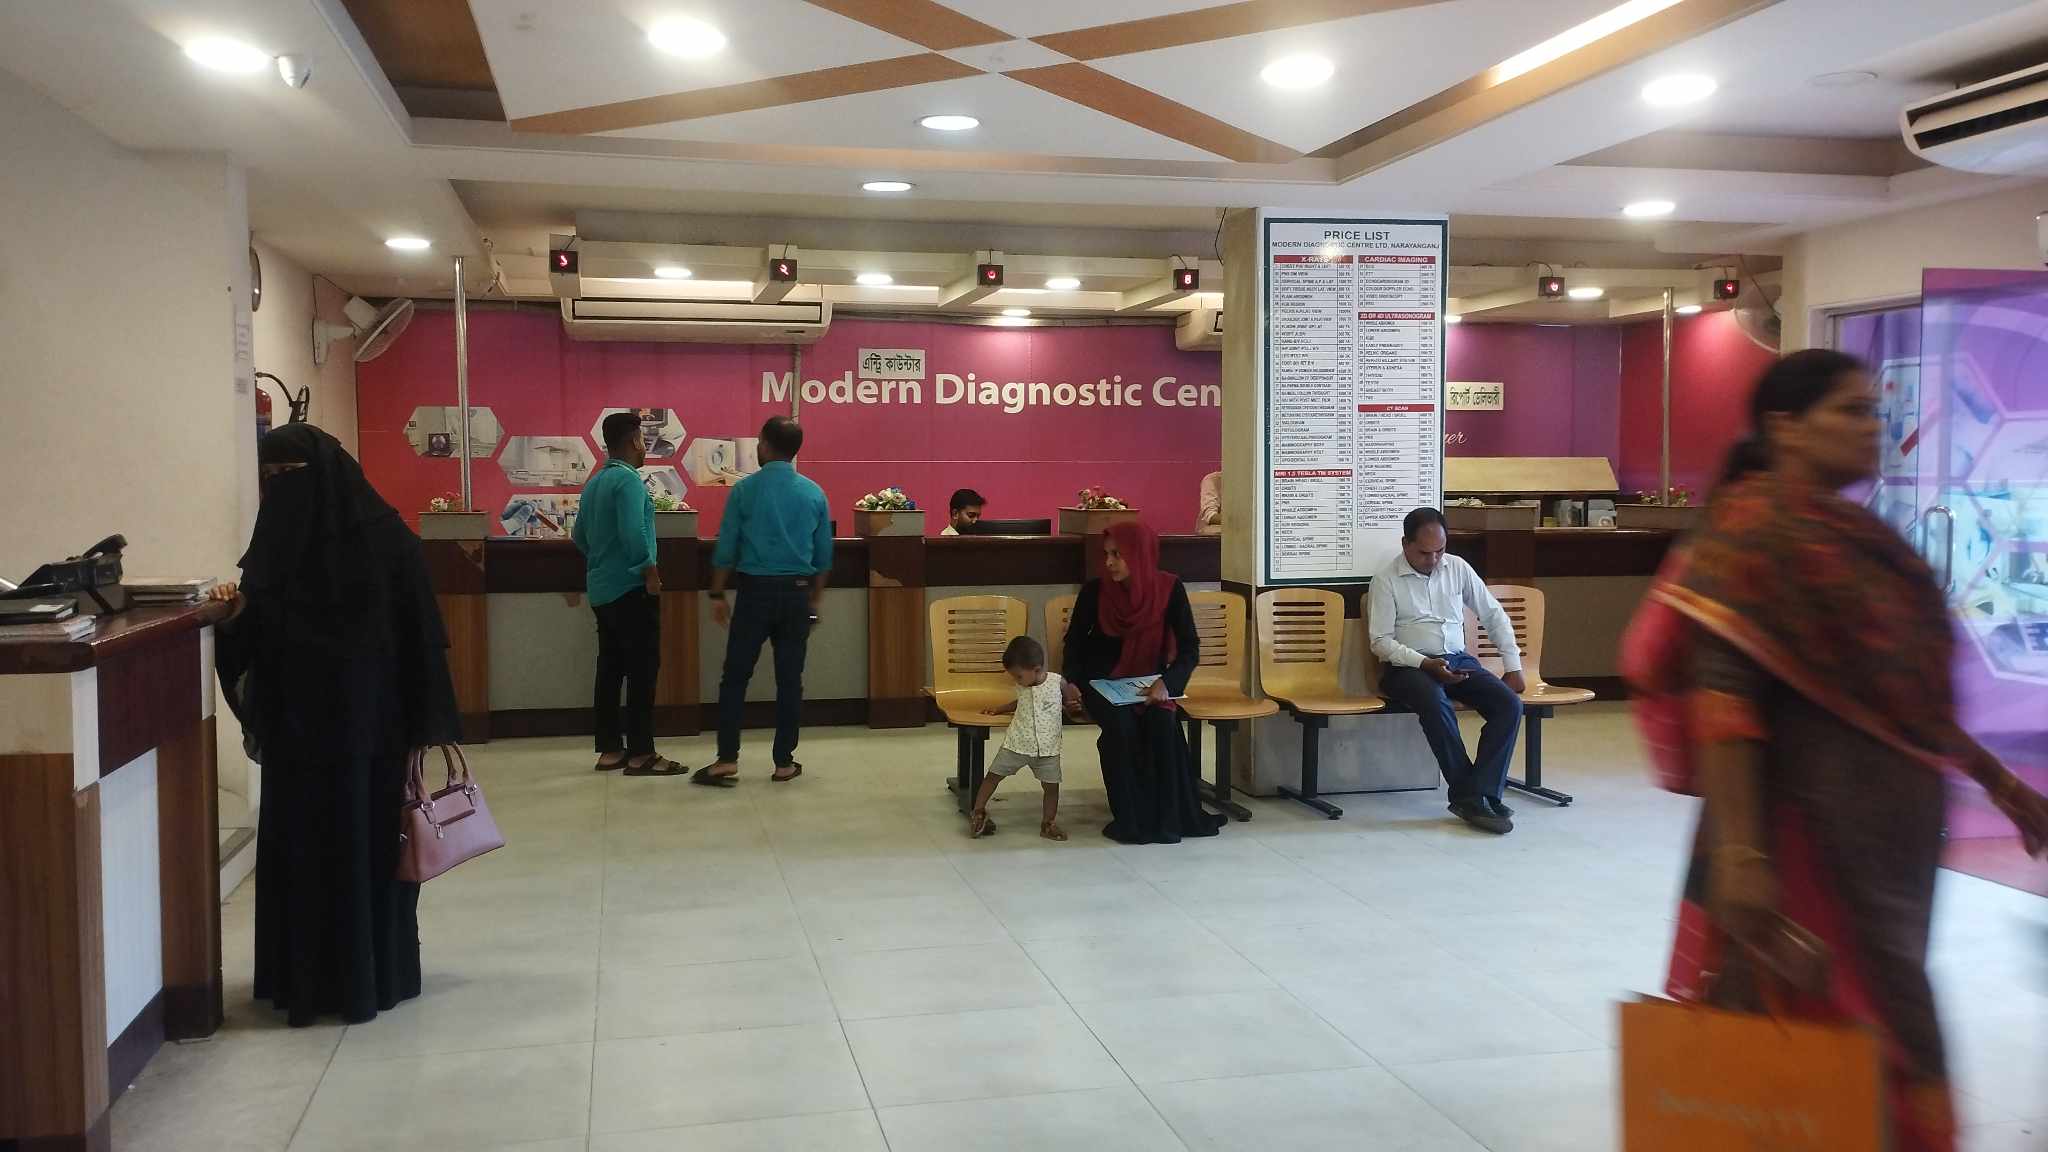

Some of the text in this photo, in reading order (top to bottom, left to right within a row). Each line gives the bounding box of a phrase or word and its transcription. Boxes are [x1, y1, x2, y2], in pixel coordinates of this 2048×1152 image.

[1324, 230, 1391, 241] PRICE LIST
[863, 353, 921, 375] এন্ট্রি কাউন্টার
[761, 371, 921, 404] Modern
[935, 373, 1142, 414] Diagnostic
